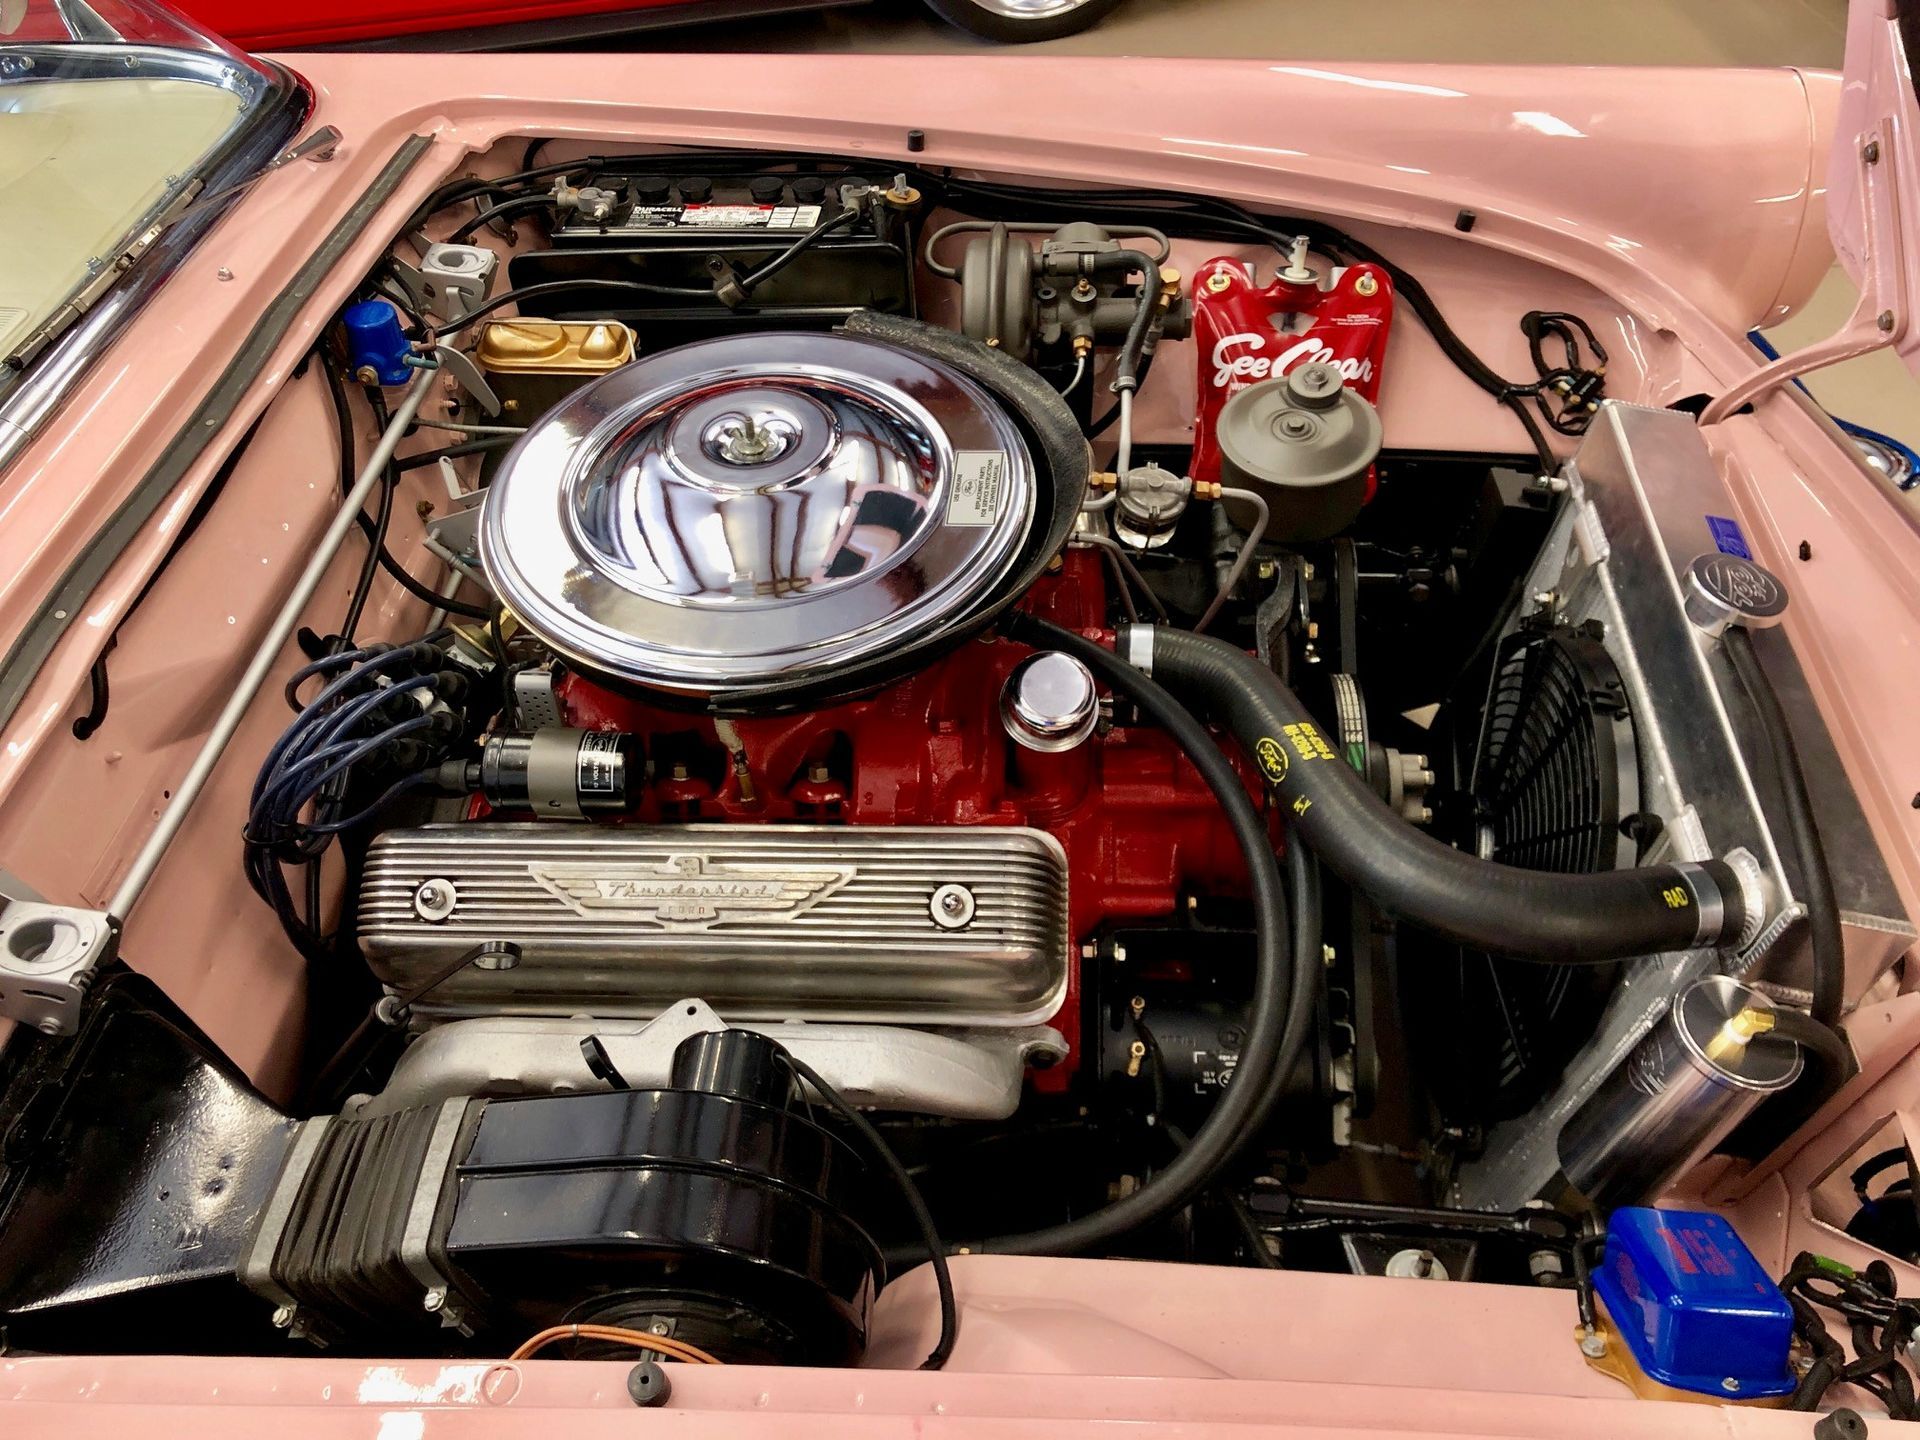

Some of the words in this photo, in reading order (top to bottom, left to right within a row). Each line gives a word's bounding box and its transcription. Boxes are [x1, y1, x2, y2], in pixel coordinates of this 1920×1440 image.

[1212, 332, 1271, 387] See
[954, 474, 962, 493] GENUINE
[985, 459, 993, 490] INSTRUCTIONS
[975, 480, 984, 510] REPLACEMENT
[609, 881, 774, 898] Thunderbird
[1662, 886, 1689, 909] RAD
[666, 905, 706, 914] FORD
